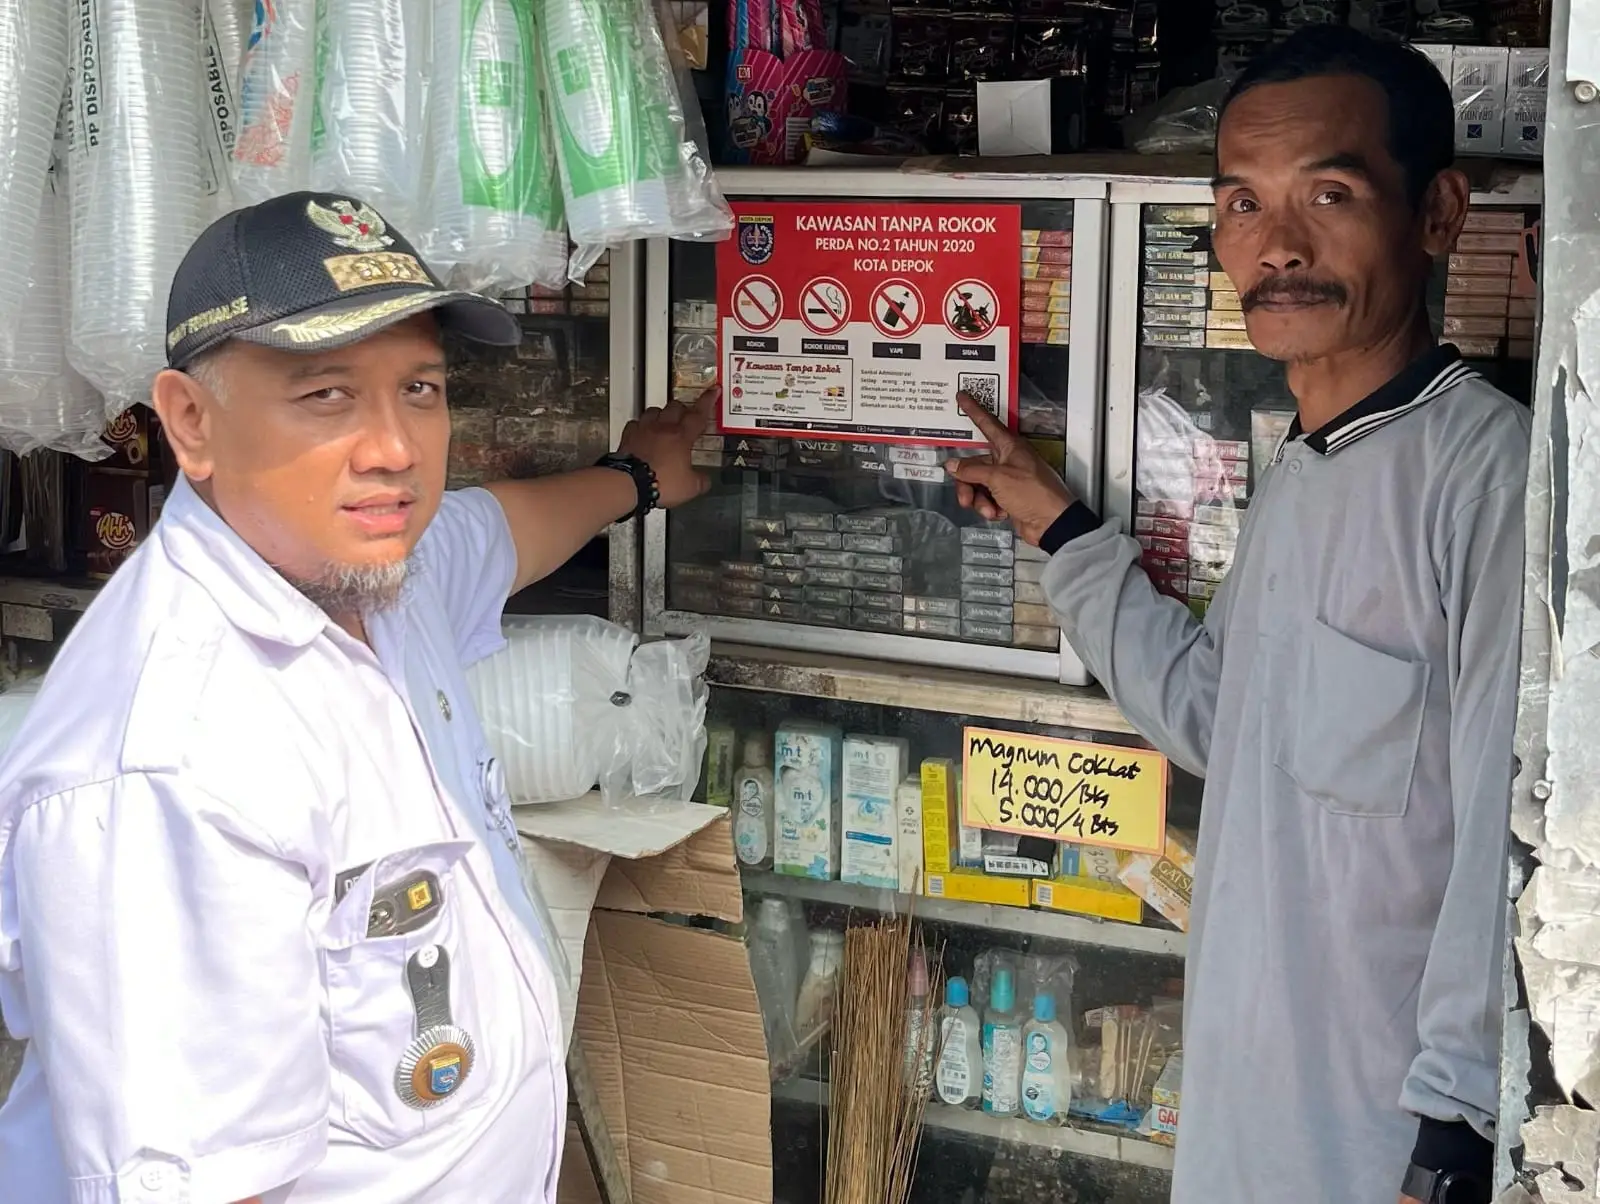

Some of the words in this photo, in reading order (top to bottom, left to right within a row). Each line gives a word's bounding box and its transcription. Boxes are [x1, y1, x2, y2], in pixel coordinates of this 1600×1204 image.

[82, 0, 99, 116] DISPOSABL
[796, 215, 876, 232] KAWASAN
[881, 216, 933, 233] TANPA
[938, 217, 996, 233] ROKOK
[815, 238, 854, 251] PERDA
[858, 239, 890, 252] NO.2
[894, 239, 938, 253] TAHUN
[942, 240, 975, 253] 2020
[854, 258, 889, 272] KOTA
[892, 259, 934, 272] DEPOK
[734, 357, 745, 372] 7
[745, 361, 783, 371] Kawasan
[785, 363, 813, 374] Tanpa
[816, 364, 841, 374] Rokok
[796, 439, 837, 452] TWIZZ
[851, 443, 877, 455] ZIGA
[861, 460, 887, 472] ZIGA
